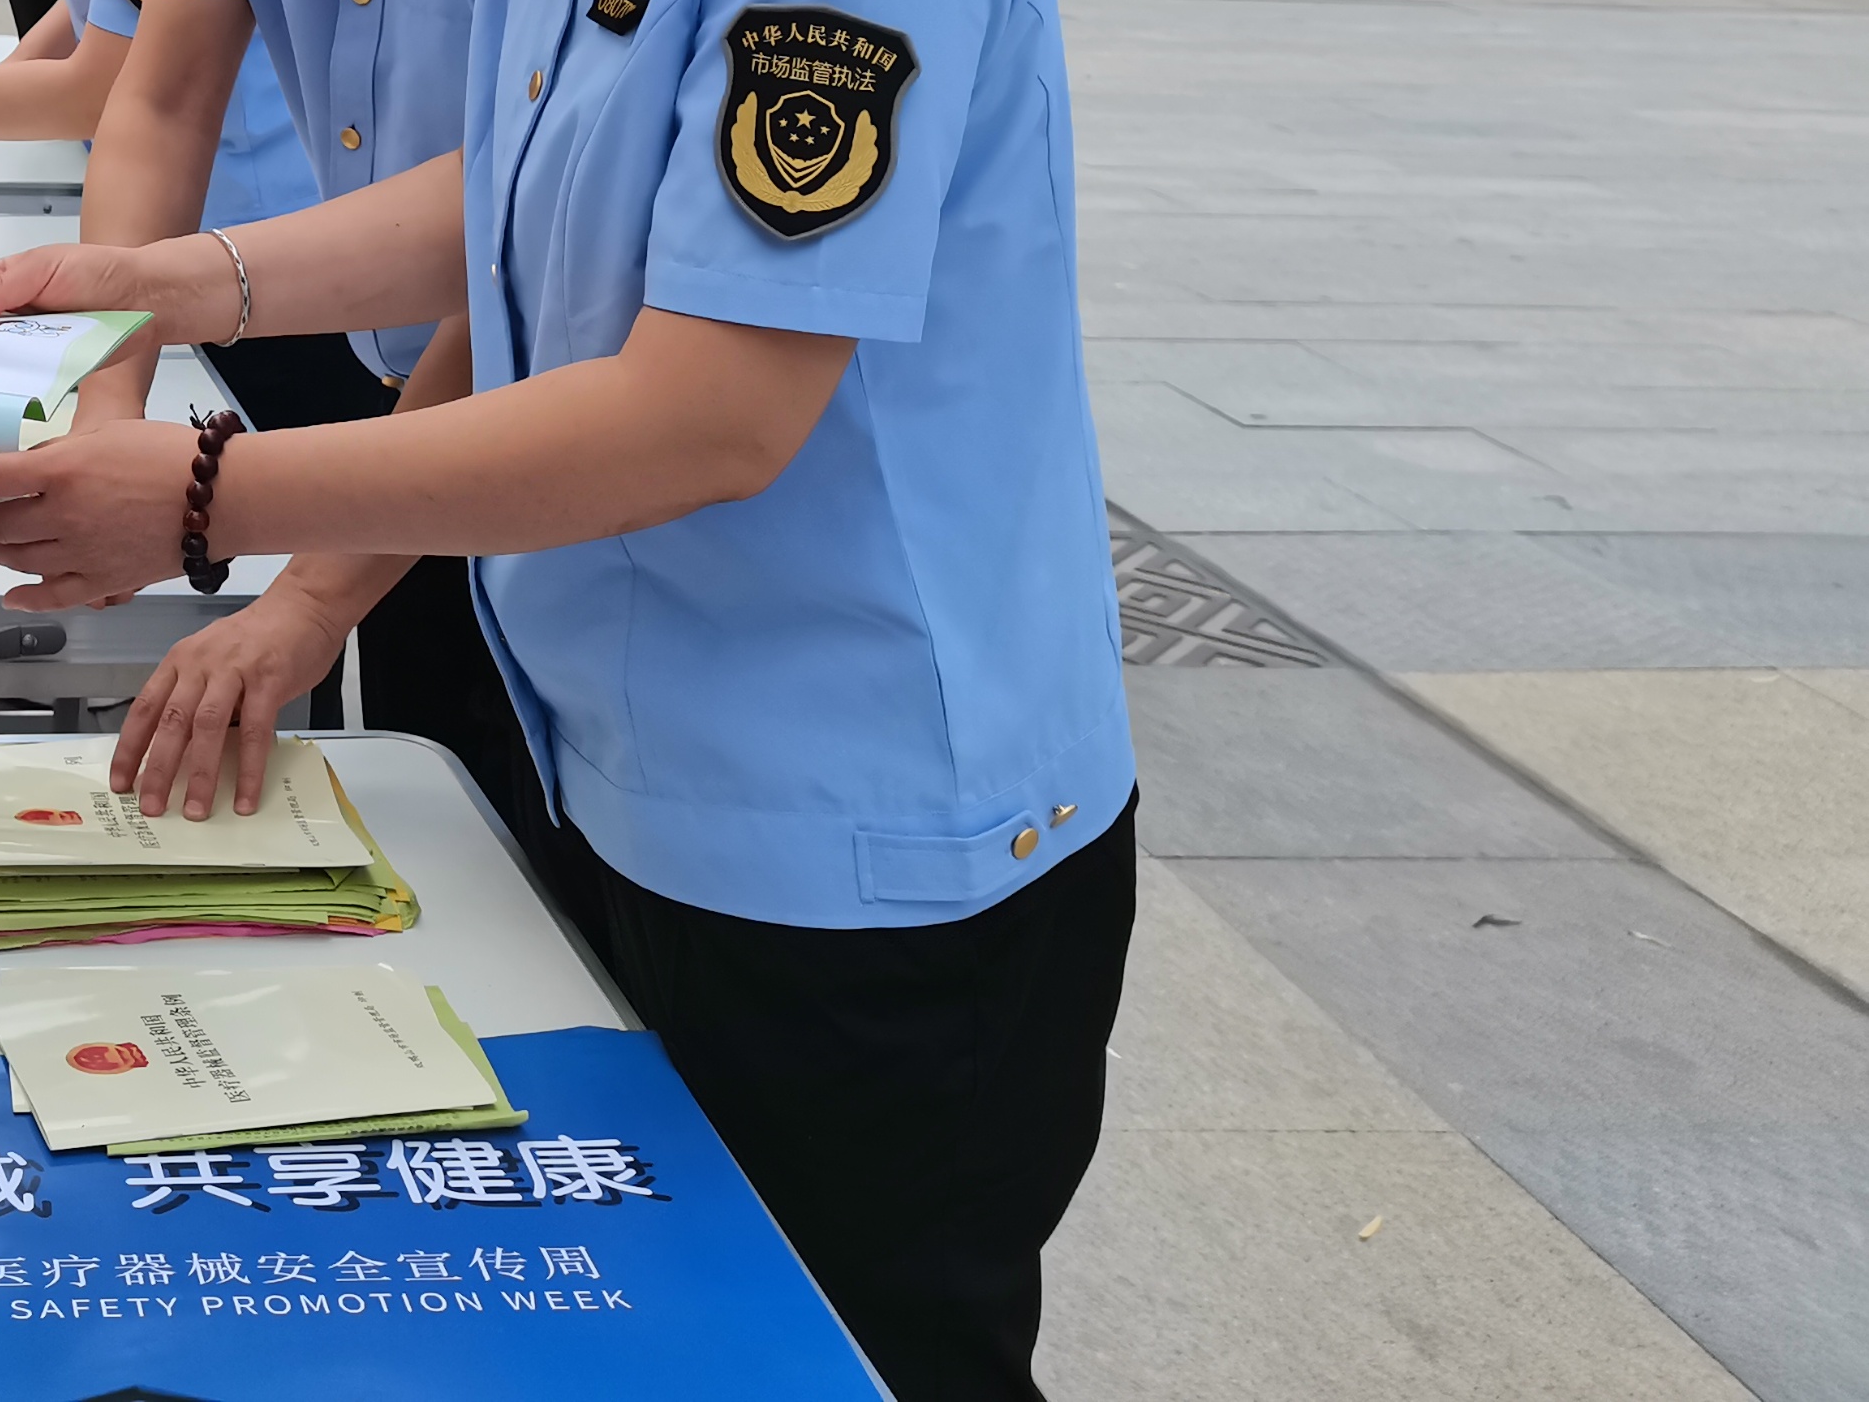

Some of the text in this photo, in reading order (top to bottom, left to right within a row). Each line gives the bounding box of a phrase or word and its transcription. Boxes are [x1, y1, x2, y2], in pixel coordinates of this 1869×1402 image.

[741, 22, 899, 73] 中华人民共和国
[751, 51, 877, 93] 市场监管执法
[140, 1014, 207, 1089] 中华人民共和国
[160, 994, 251, 1104] 医疗器械监督管理条例
[124, 1134, 654, 1210] 共享健康
[10, 1297, 178, 1321] SAFETY
[201, 1291, 484, 1317] PROMOTION
[500, 1288, 633, 1312] WEEK
